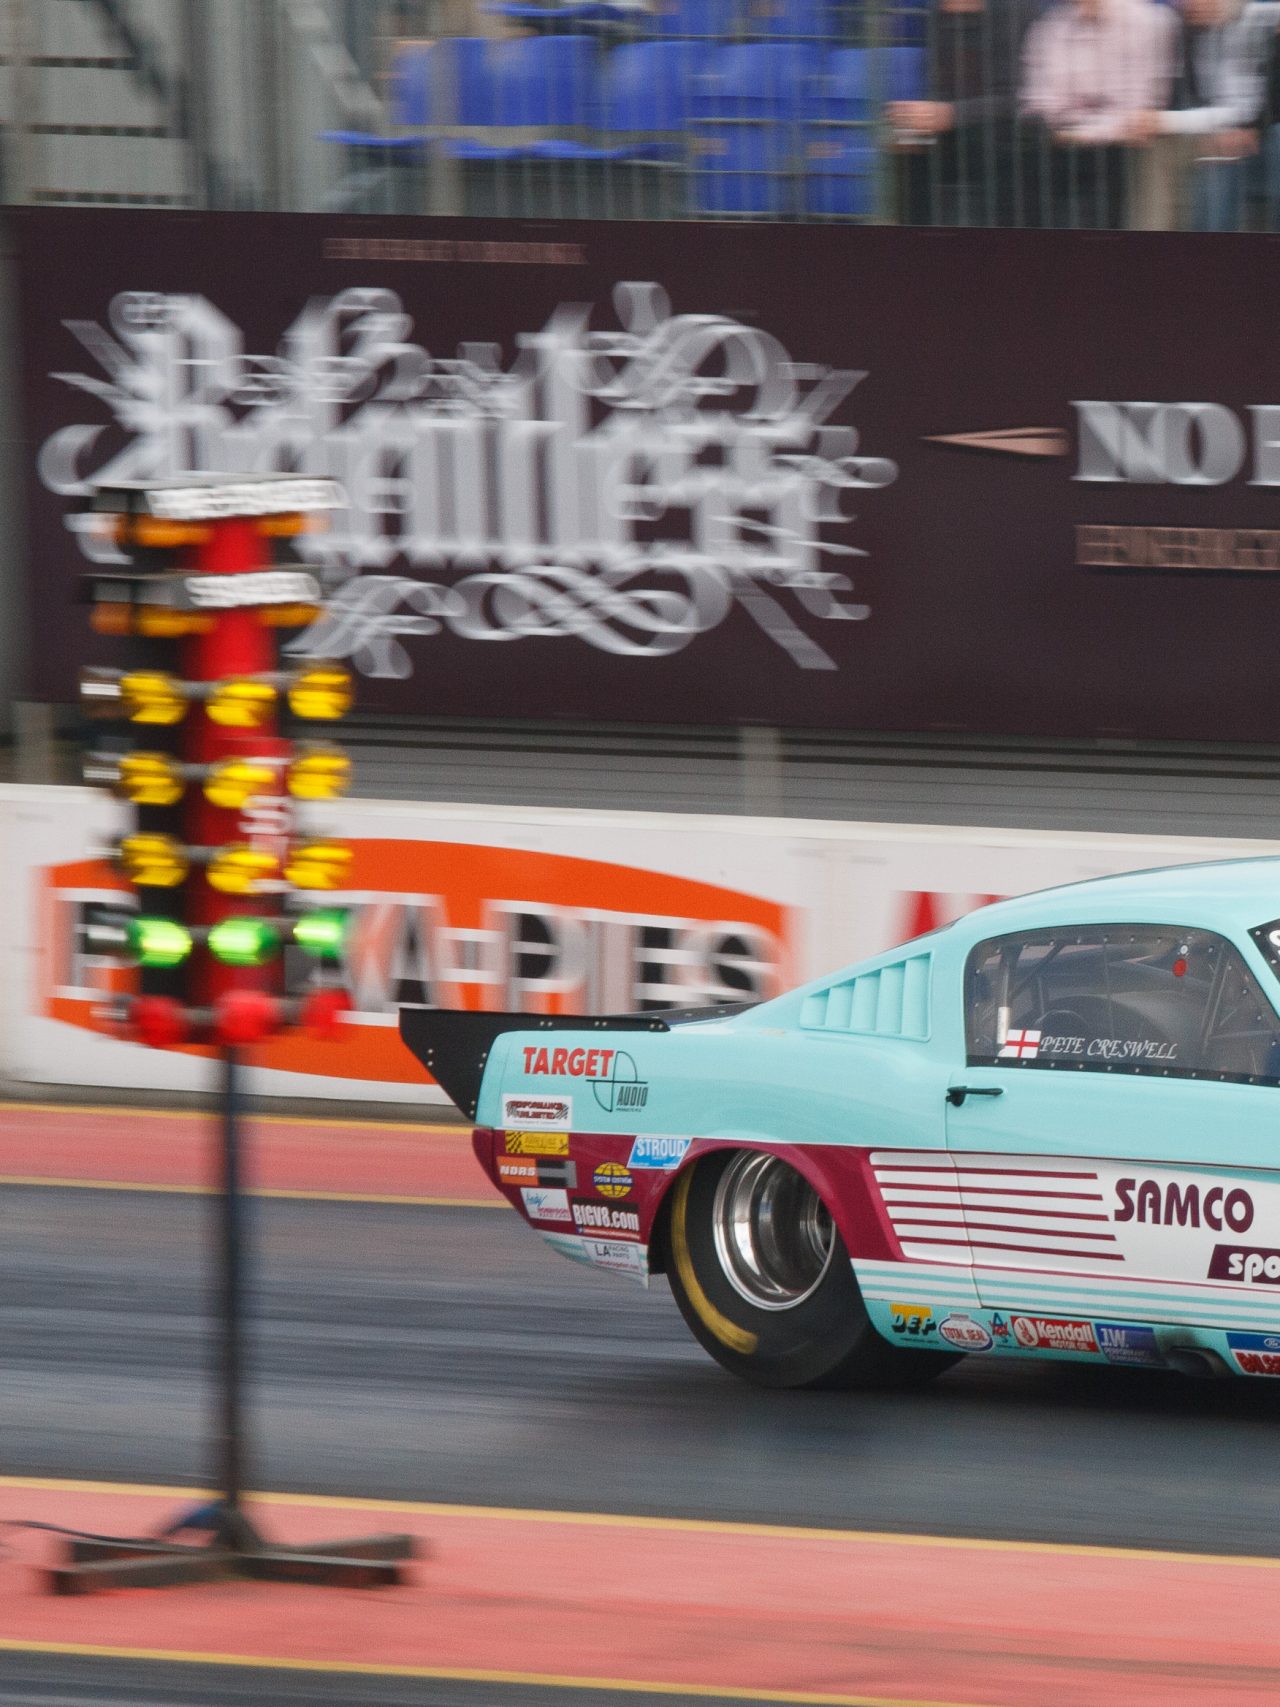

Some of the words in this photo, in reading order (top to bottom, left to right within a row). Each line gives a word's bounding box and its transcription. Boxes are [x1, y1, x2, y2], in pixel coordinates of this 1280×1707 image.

[1069, 400, 1246, 486] NO
[1039, 1036, 1086, 1053] PETE
[1087, 1038, 1178, 1060] CRESWELL
[522, 1046, 615, 1077] TARGET
[616, 1086, 649, 1107] AUDIO
[637, 1138, 686, 1157] STROUD
[572, 1204, 640, 1231] BIGV8.com
[1113, 1178, 1254, 1233] SAMCO
[1036, 1321, 1093, 1343] Kendall
